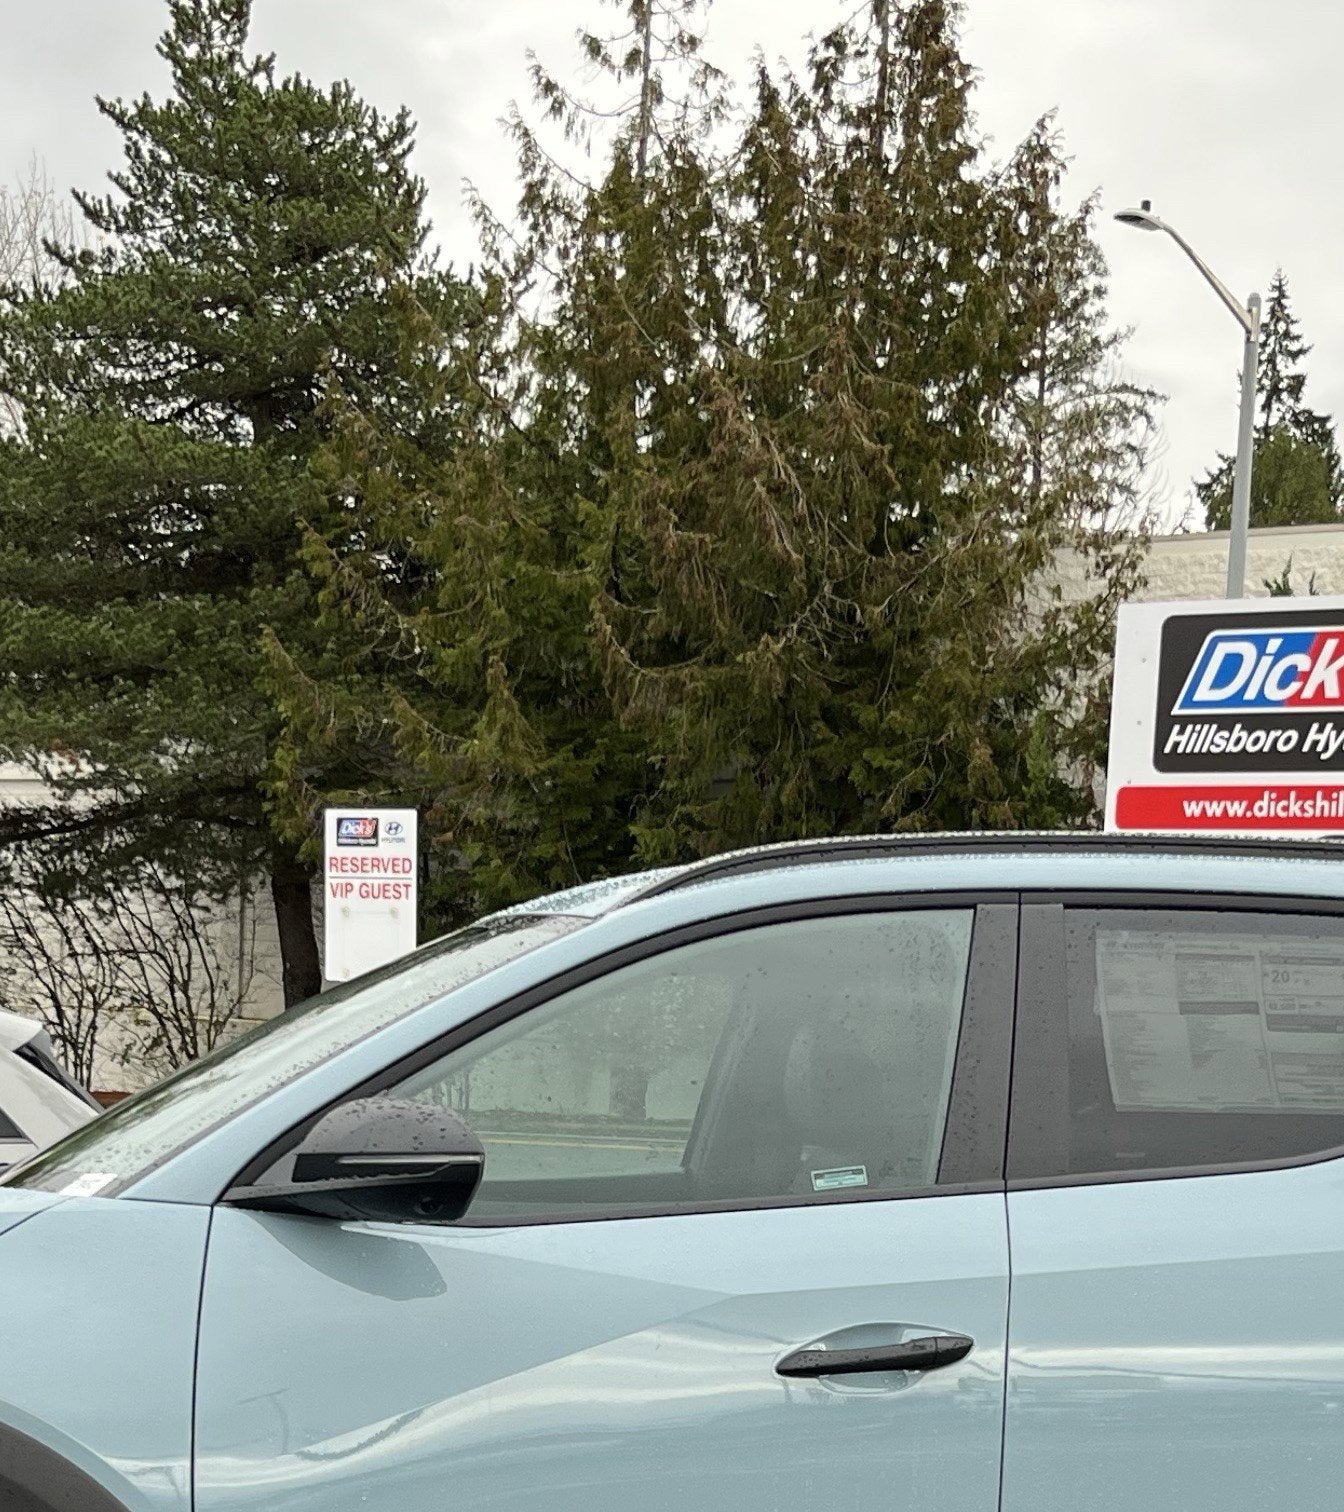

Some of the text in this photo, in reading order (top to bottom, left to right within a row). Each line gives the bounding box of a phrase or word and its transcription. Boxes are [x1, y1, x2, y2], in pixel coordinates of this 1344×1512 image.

[1163, 723, 1299, 754] Hillsboro
[329, 857, 412, 874] RESERVED
[330, 882, 412, 900] VIP GUEST
